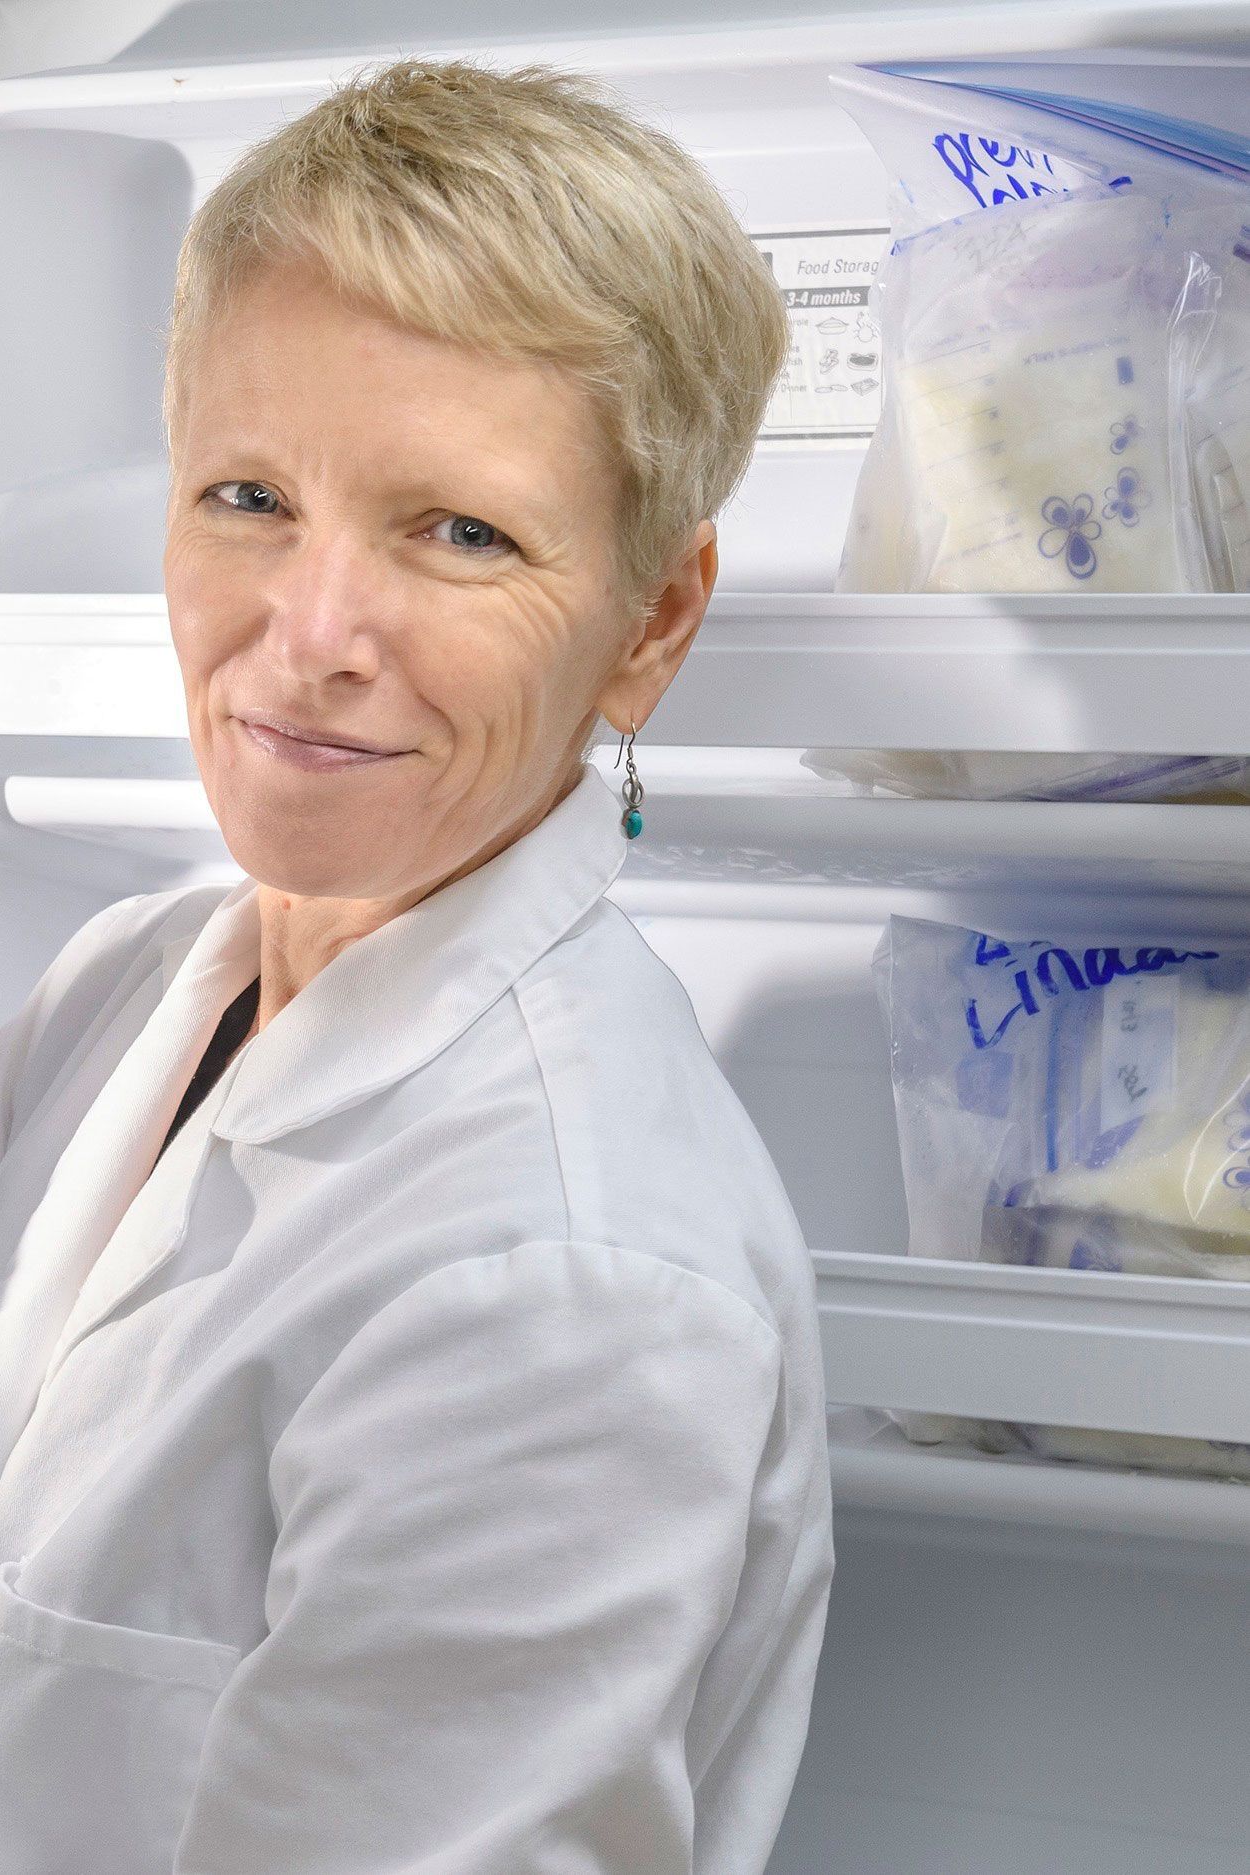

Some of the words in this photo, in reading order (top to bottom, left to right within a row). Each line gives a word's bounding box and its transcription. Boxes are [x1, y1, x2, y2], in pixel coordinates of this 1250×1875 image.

[797, 260, 830, 275] Food
[787, 292, 807, 307] 3-4
[811, 289, 861, 306] months
